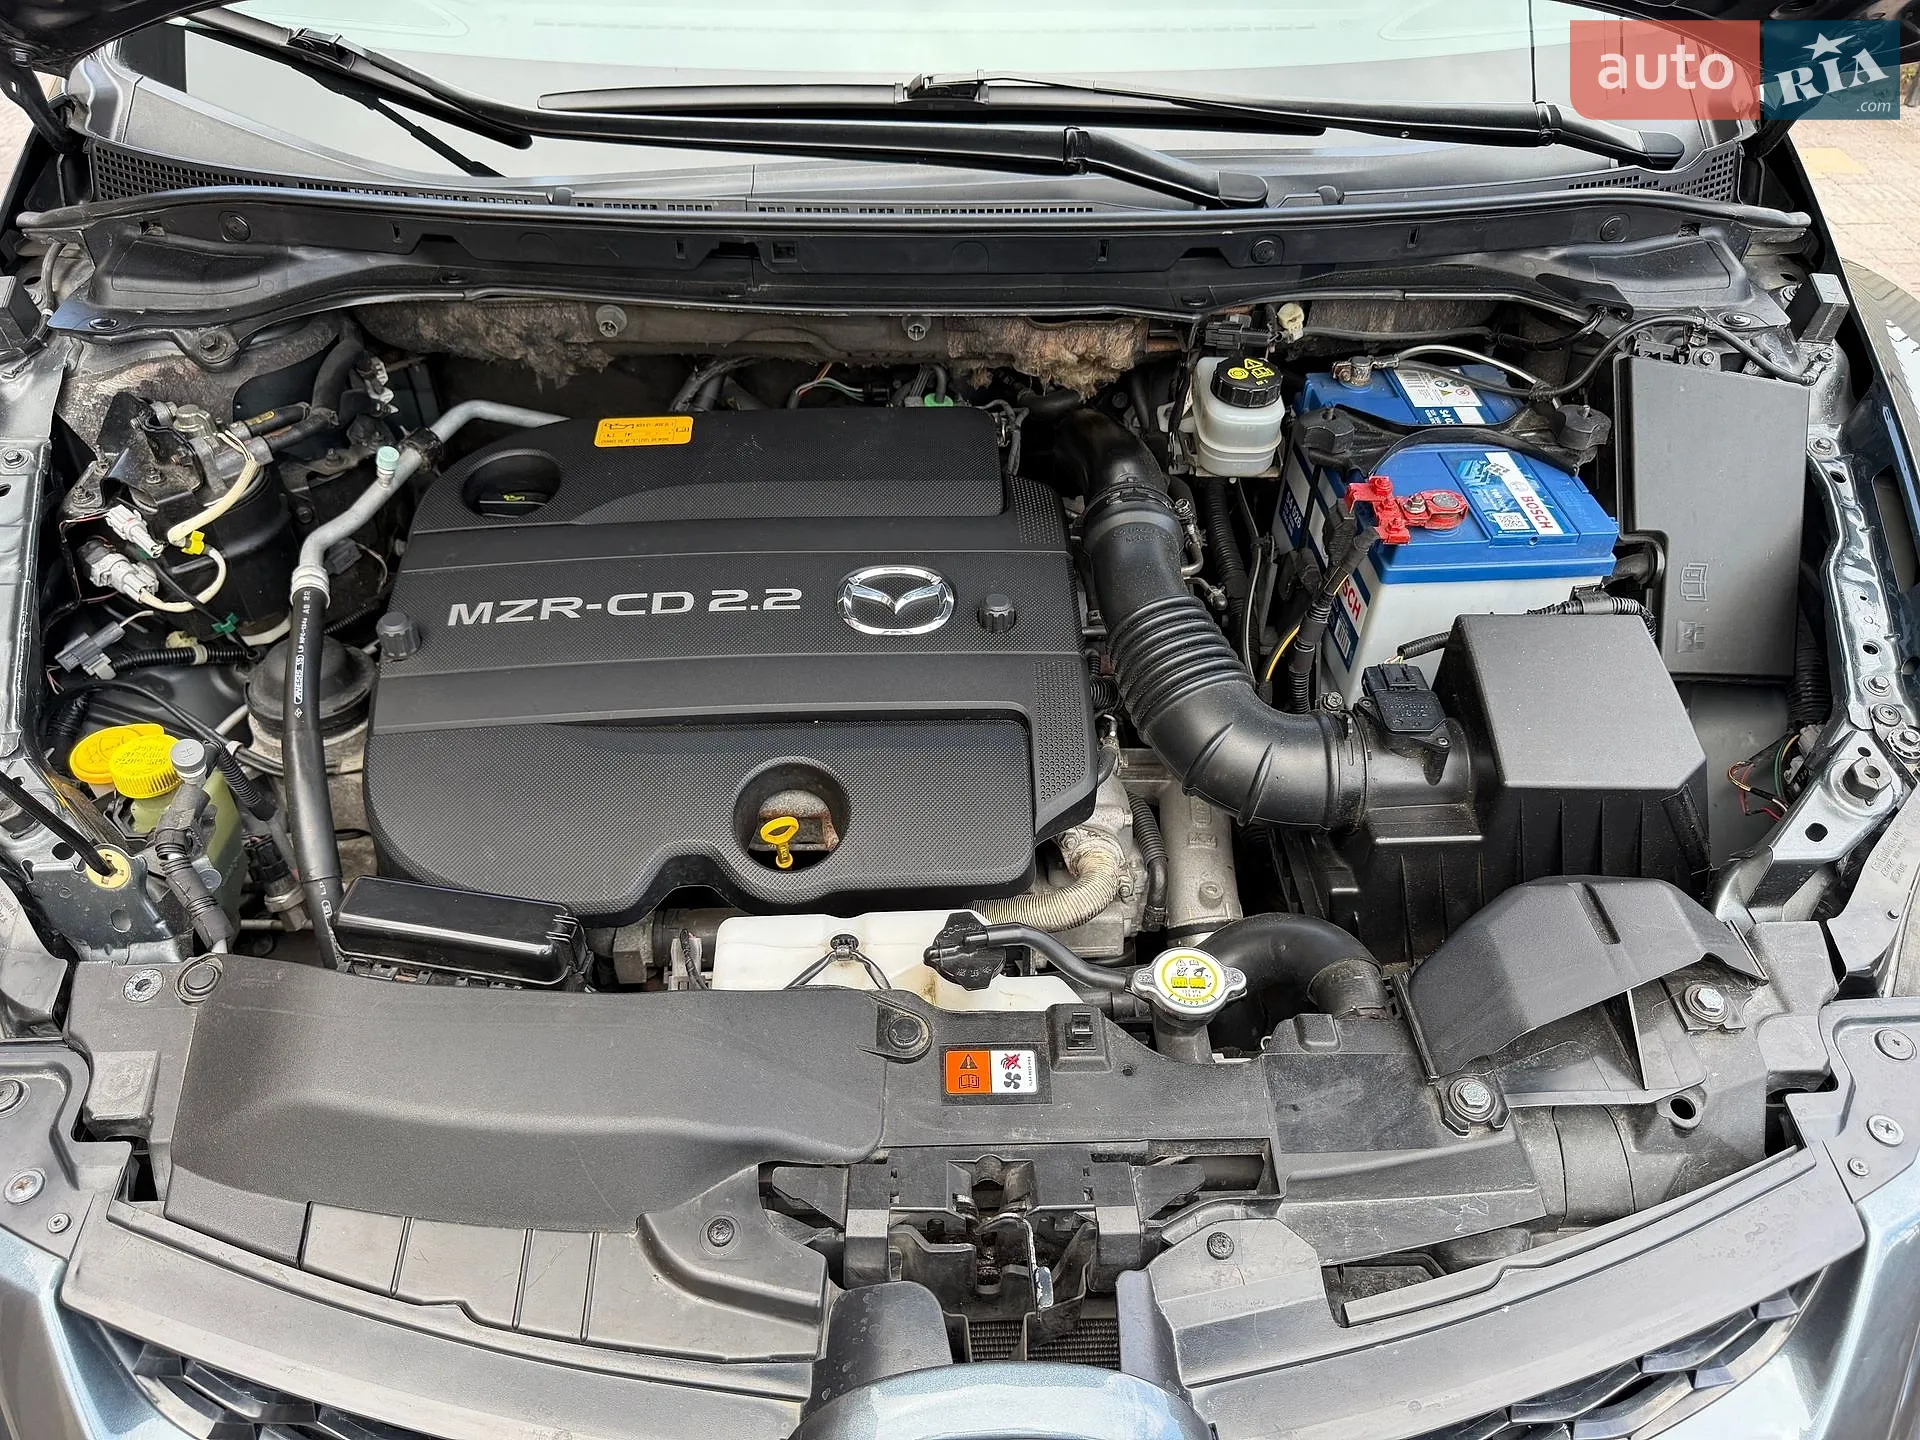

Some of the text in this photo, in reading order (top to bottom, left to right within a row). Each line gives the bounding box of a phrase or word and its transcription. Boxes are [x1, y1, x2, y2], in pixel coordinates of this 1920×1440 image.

[1520, 495, 1554, 529] BOSCH
[447, 587, 803, 627] MZR-CD 2.2
[1341, 578, 1361, 621] SCH
